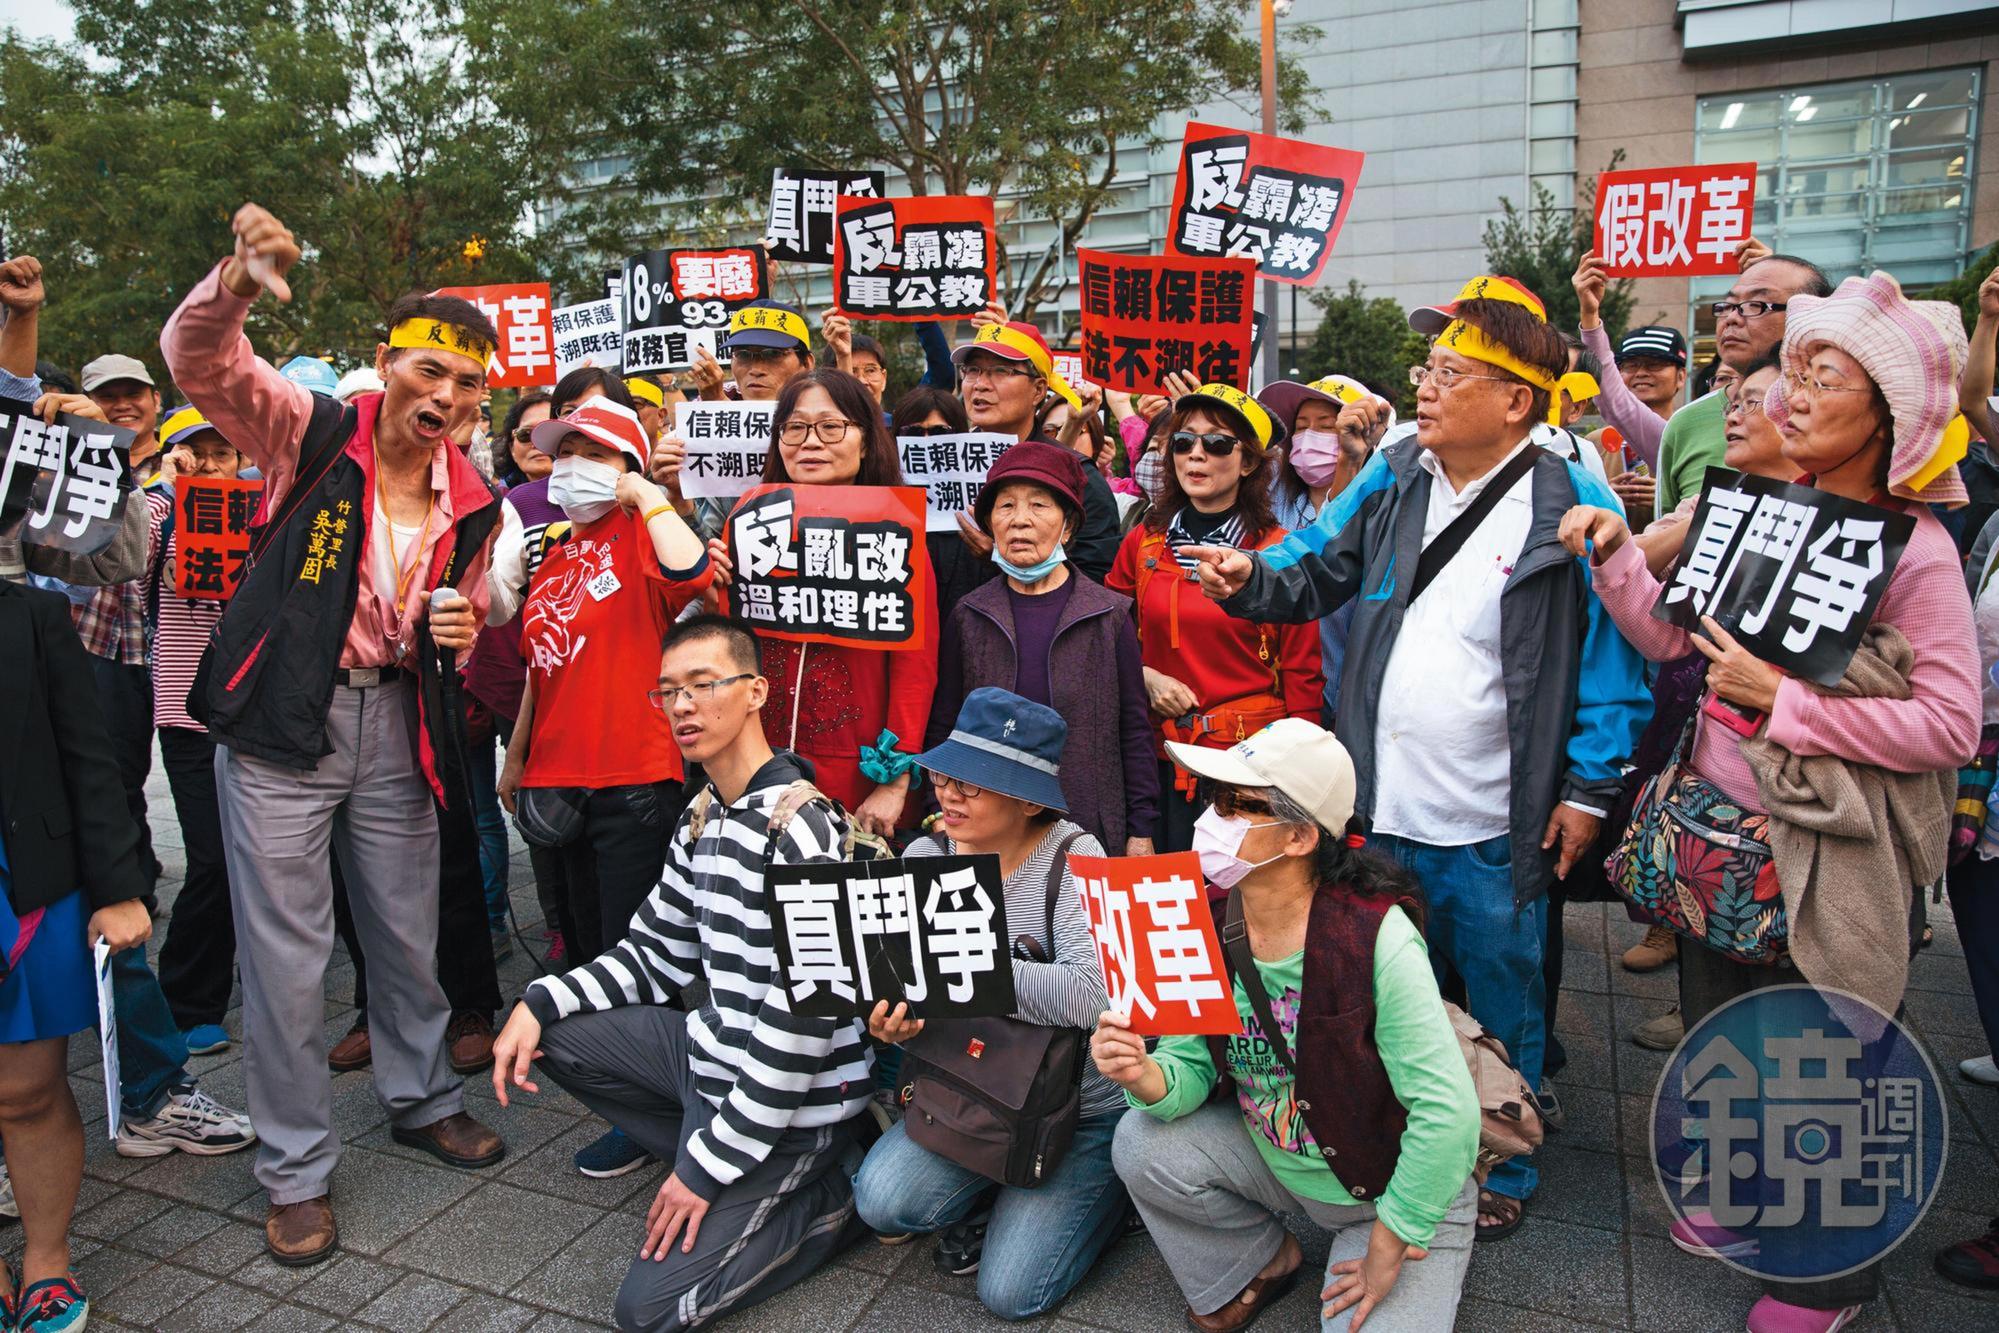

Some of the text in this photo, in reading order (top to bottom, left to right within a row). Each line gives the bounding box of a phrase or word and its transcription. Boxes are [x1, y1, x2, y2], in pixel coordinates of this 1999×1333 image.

[1191, 146, 1339, 232] 反霸凌
[1600, 176, 1749, 267] 假改革
[842, 210, 985, 275] 反霸凌
[1182, 212, 1321, 272] 軍公教
[623, 254, 754, 325] 18% 要廢
[680, 301, 740, 326] 93
[846, 274, 986, 309] 軍公教
[1082, 260, 1245, 325] 信賴保護
[464, 294, 551, 379] 革
[553, 331, 622, 363] 溯既往
[1084, 327, 1241, 390] 法不溯往
[0, 413, 124, 539] 鬥爭
[734, 499, 909, 583] 反亂改
[1665, 486, 1885, 654] 真鬥爭
[738, 582, 906, 632] 溫和理性
[773, 866, 998, 1004] 真鬥爭
[1072, 874, 1225, 1021] 改革
